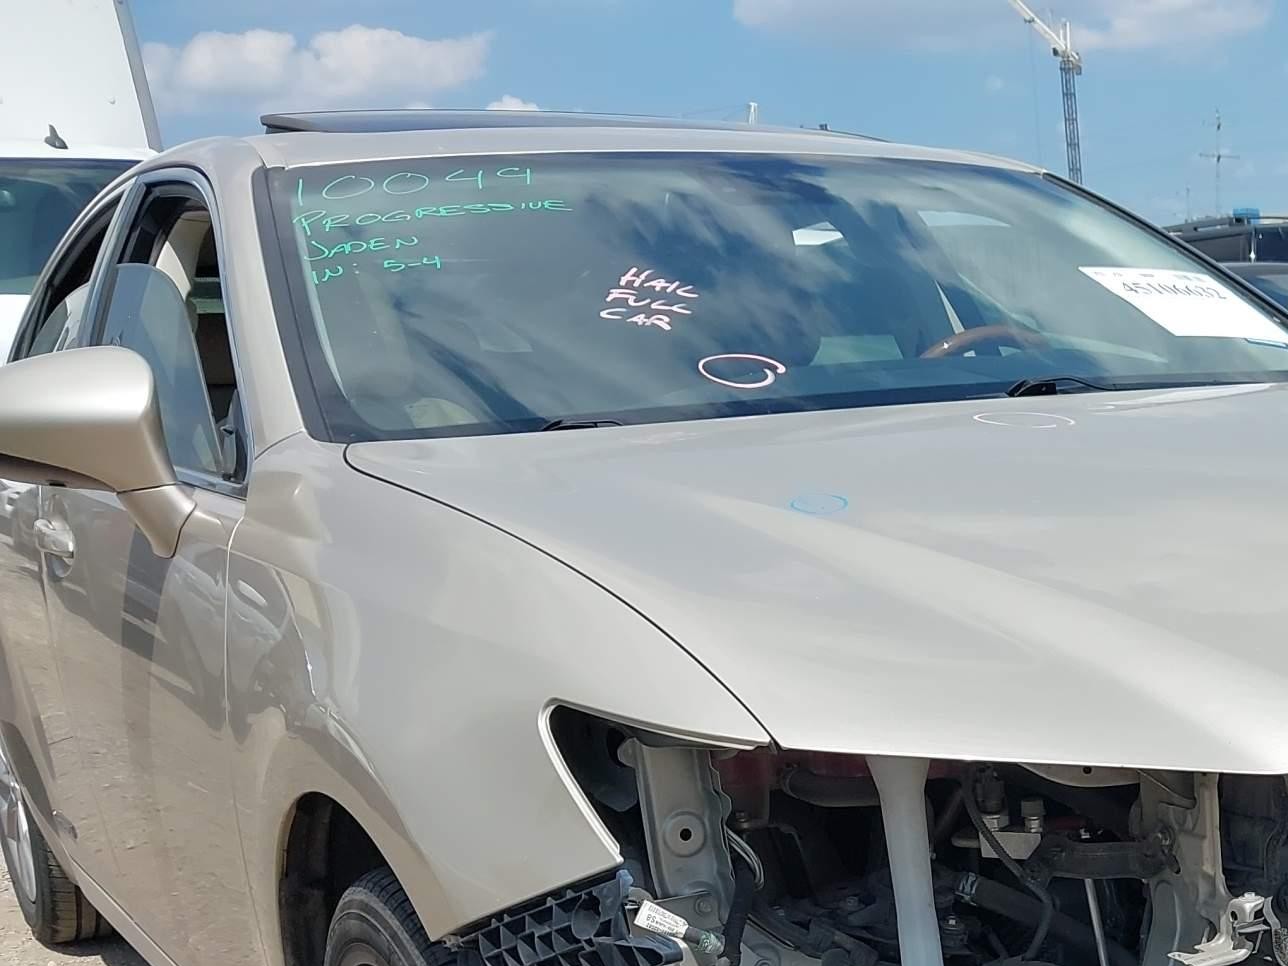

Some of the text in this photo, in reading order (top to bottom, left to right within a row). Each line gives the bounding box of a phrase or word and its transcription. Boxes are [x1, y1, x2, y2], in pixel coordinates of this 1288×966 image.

[296, 167, 531, 206] 10049
[292, 199, 574, 236] PROGRESSIVE
[303, 236, 419, 261] JADEN
[383, 256, 441, 272] 5-4
[619, 267, 699, 298] HAIL
[1122, 281, 1227, 300] 45106632
[605, 288, 693, 315] FULL
[599, 307, 673, 331] CAR
